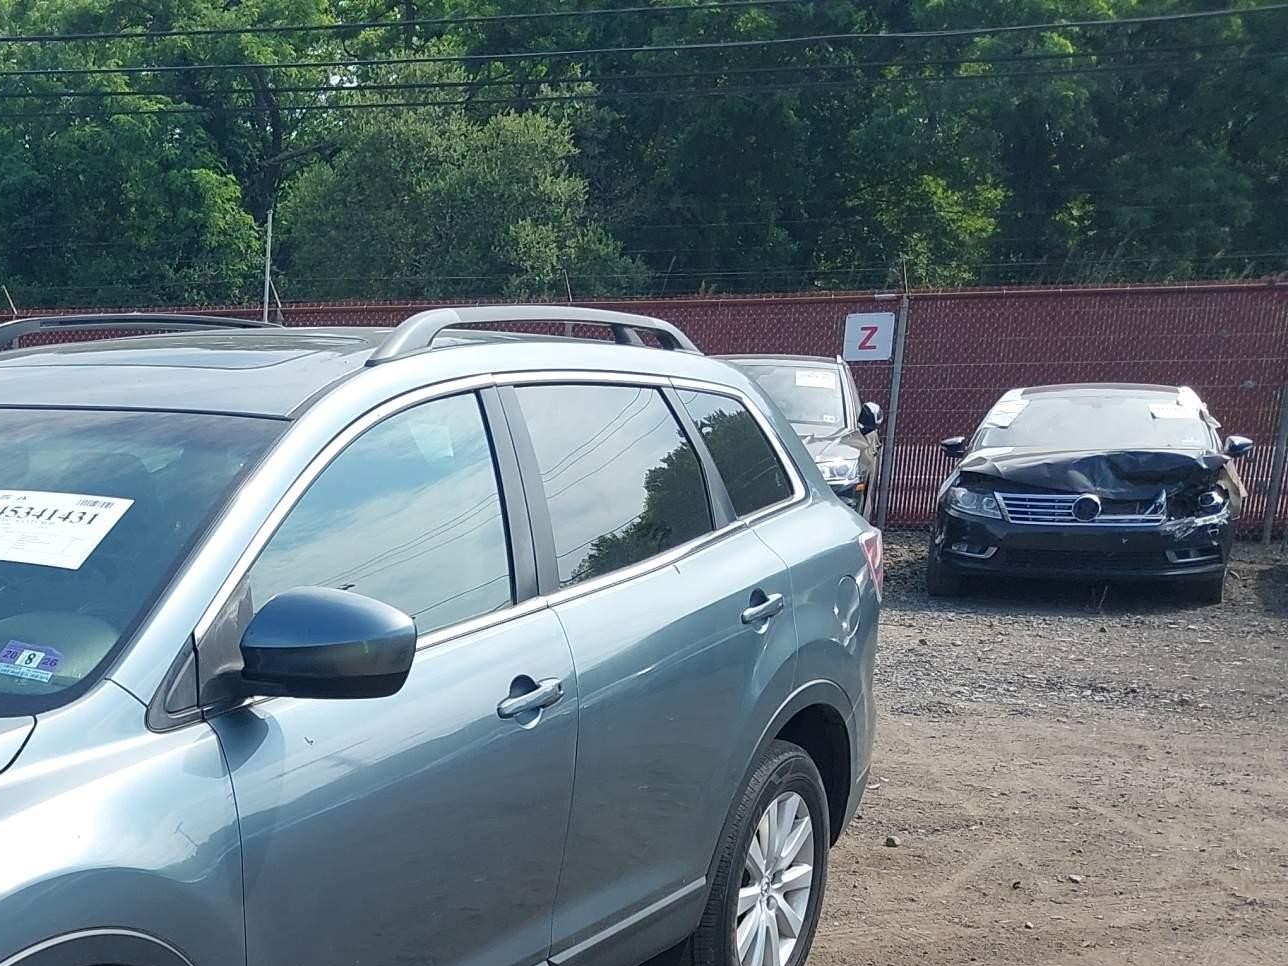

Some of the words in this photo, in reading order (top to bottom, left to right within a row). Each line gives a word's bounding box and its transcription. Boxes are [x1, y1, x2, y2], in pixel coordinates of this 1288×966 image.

[858, 326, 879, 351] Z
[2, 650, 19, 659] 20
[24, 652, 37, 665] 8
[41, 657, 59, 667] 26
